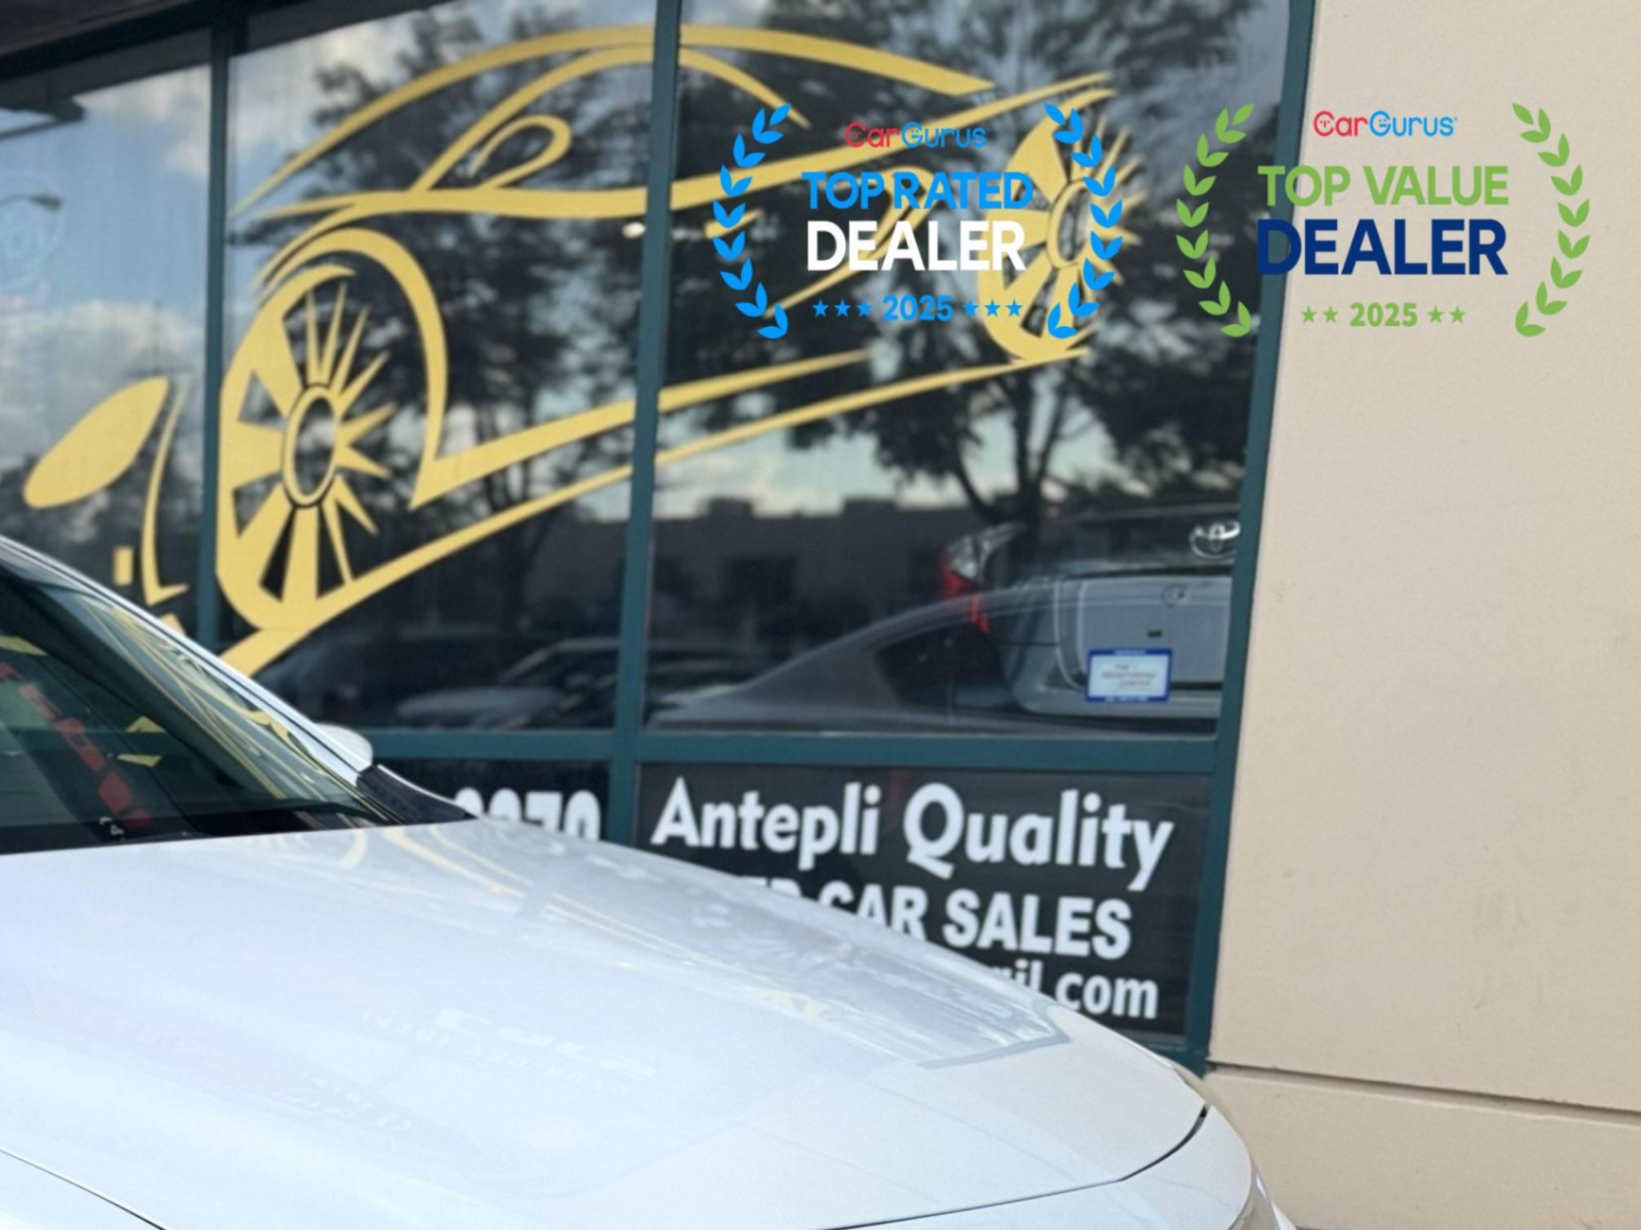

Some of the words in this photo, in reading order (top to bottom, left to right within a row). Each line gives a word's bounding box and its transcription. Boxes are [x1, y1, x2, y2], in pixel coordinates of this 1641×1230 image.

[651, 776, 881, 872] Antepli
[902, 782, 1175, 892] Quality
[942, 888, 1134, 960] SALES
